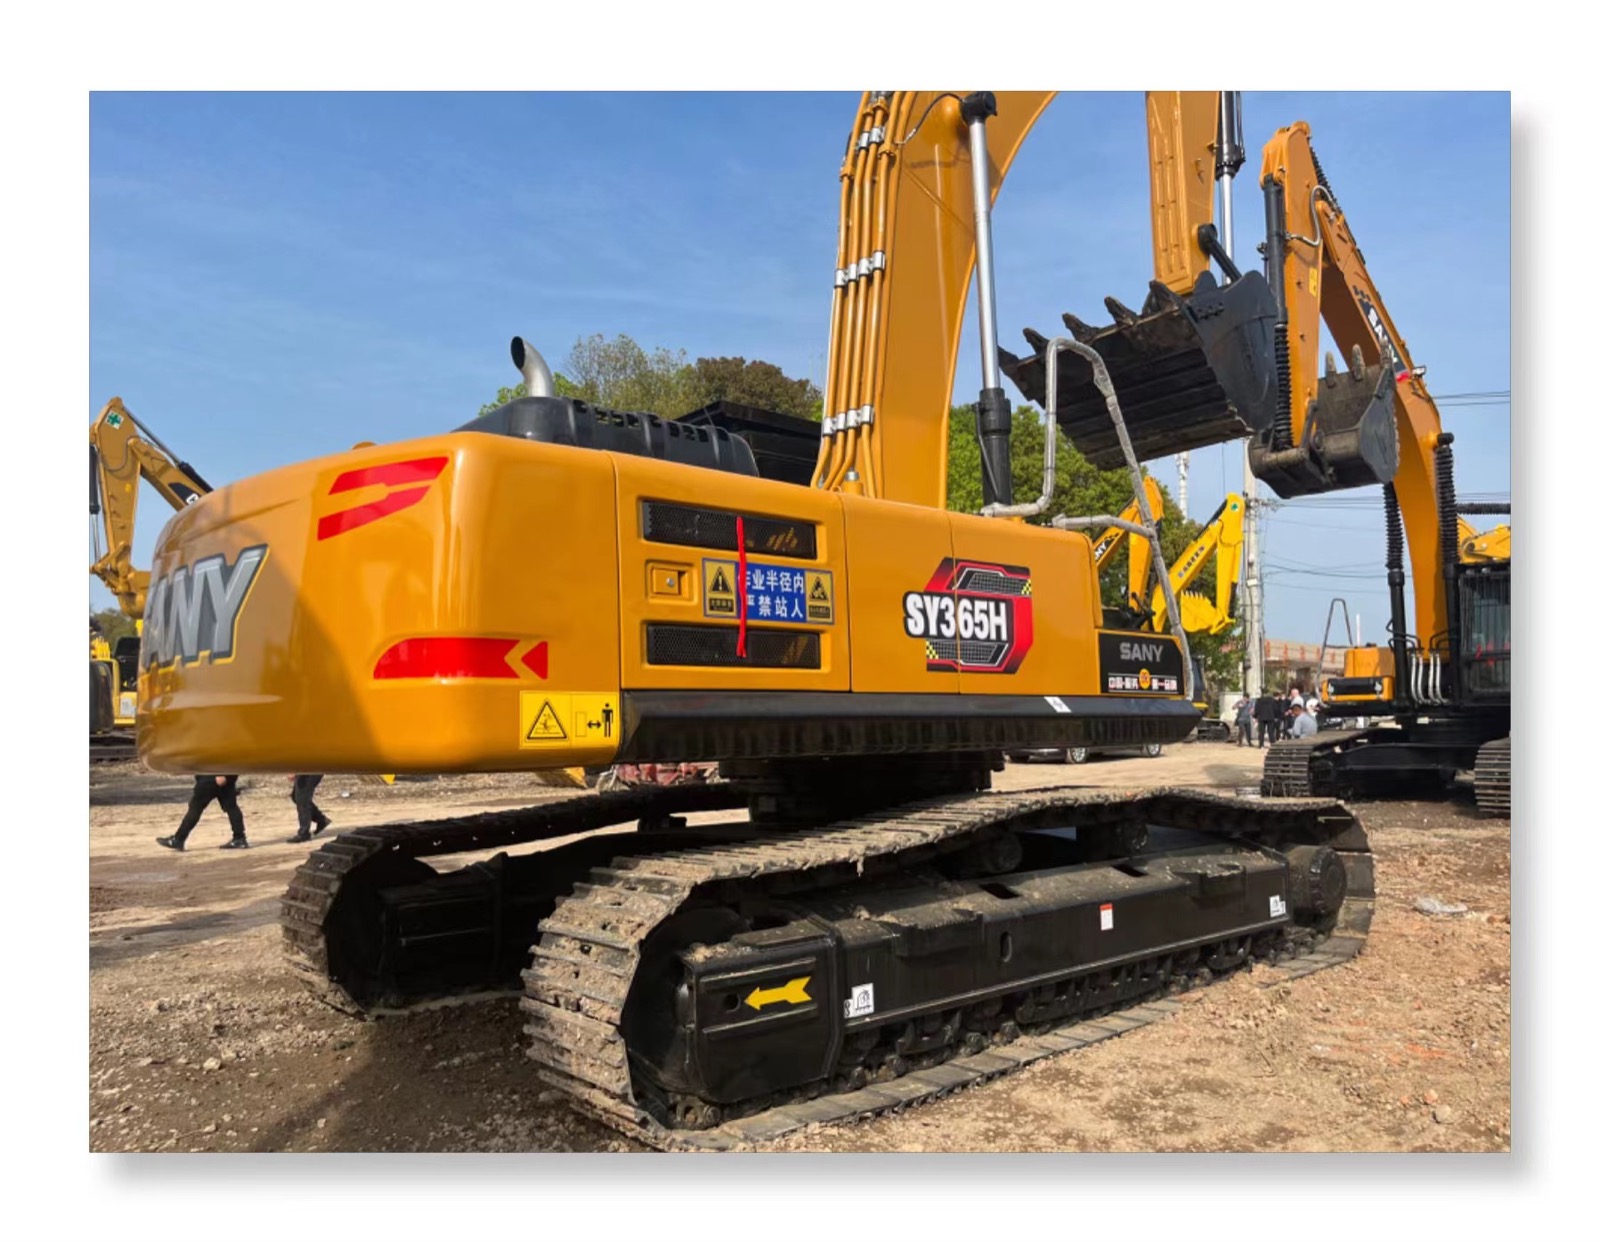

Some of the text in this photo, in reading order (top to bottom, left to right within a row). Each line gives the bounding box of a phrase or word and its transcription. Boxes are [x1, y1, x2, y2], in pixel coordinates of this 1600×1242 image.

[143, 544, 268, 669] ANY
[905, 592, 1008, 641] SY365H
[1119, 642, 1163, 662] SANY
